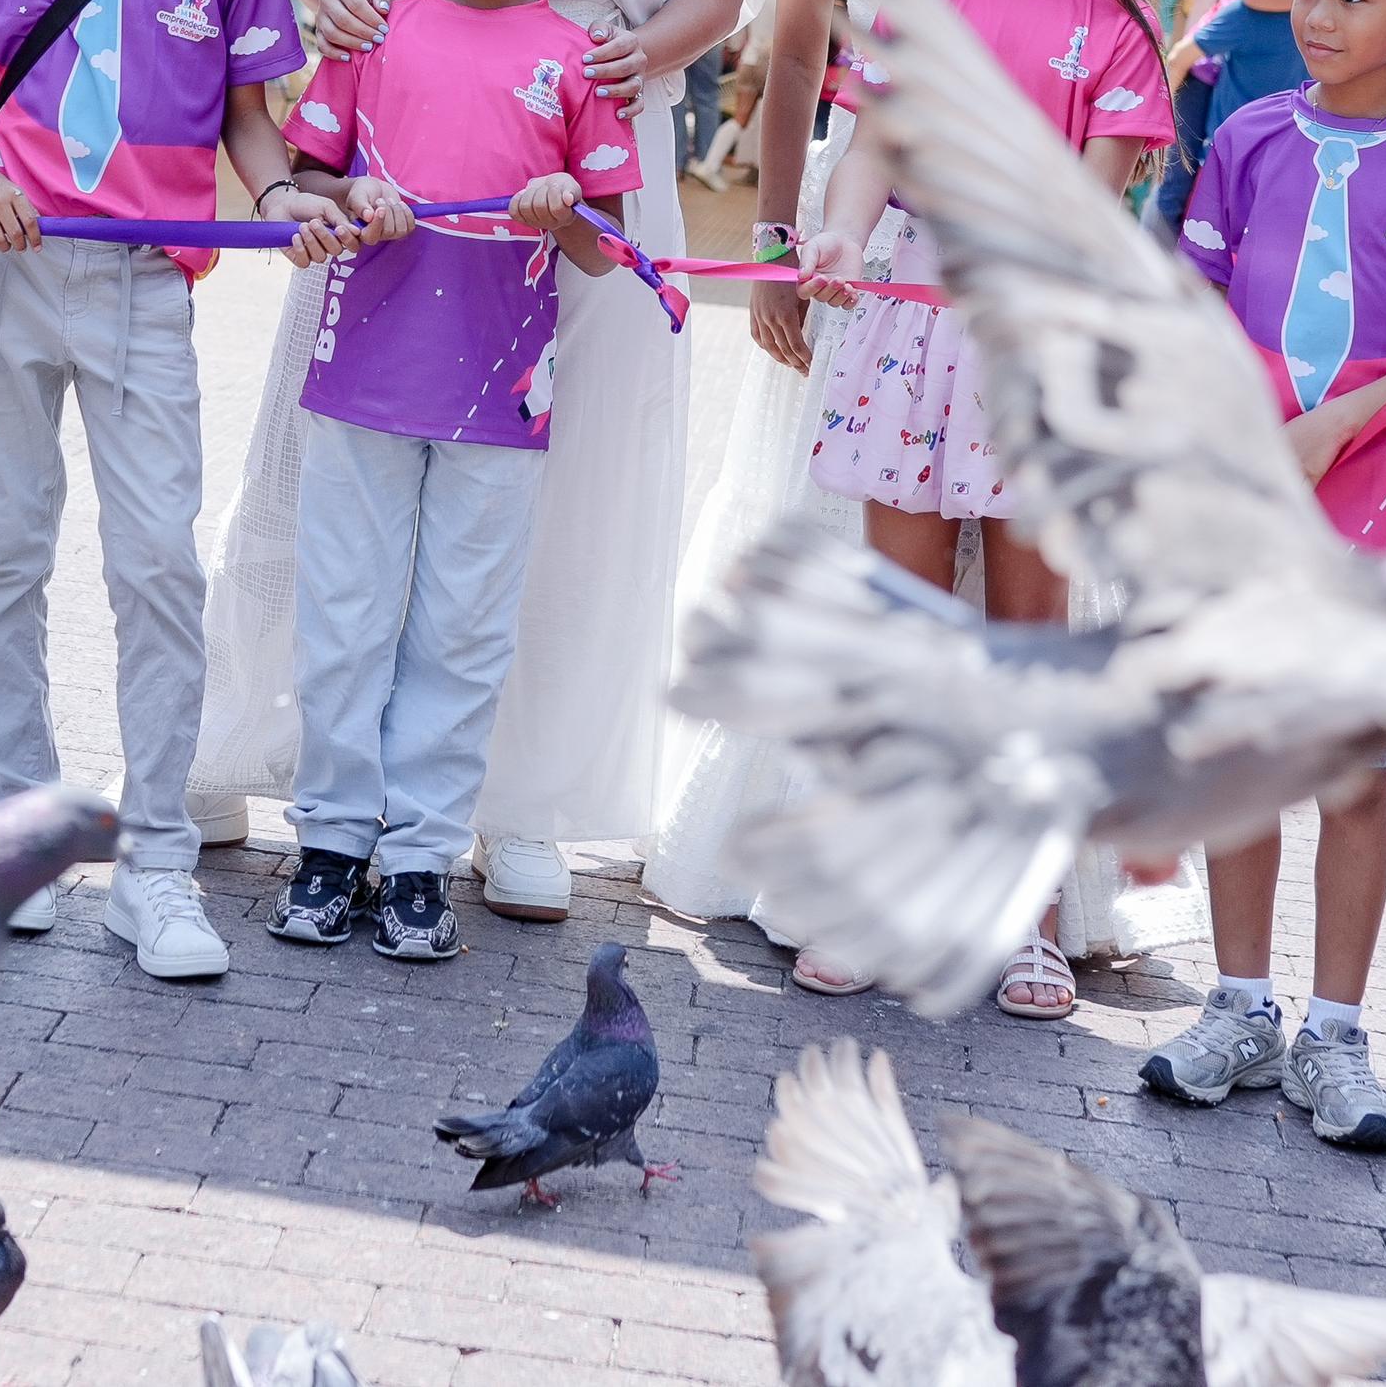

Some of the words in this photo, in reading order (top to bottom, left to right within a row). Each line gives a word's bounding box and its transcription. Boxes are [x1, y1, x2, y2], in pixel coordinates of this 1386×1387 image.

[159, 12, 217, 35] emprendedores
[1237, 1038, 1261, 1061] N
[1303, 1059, 1319, 1083] N
